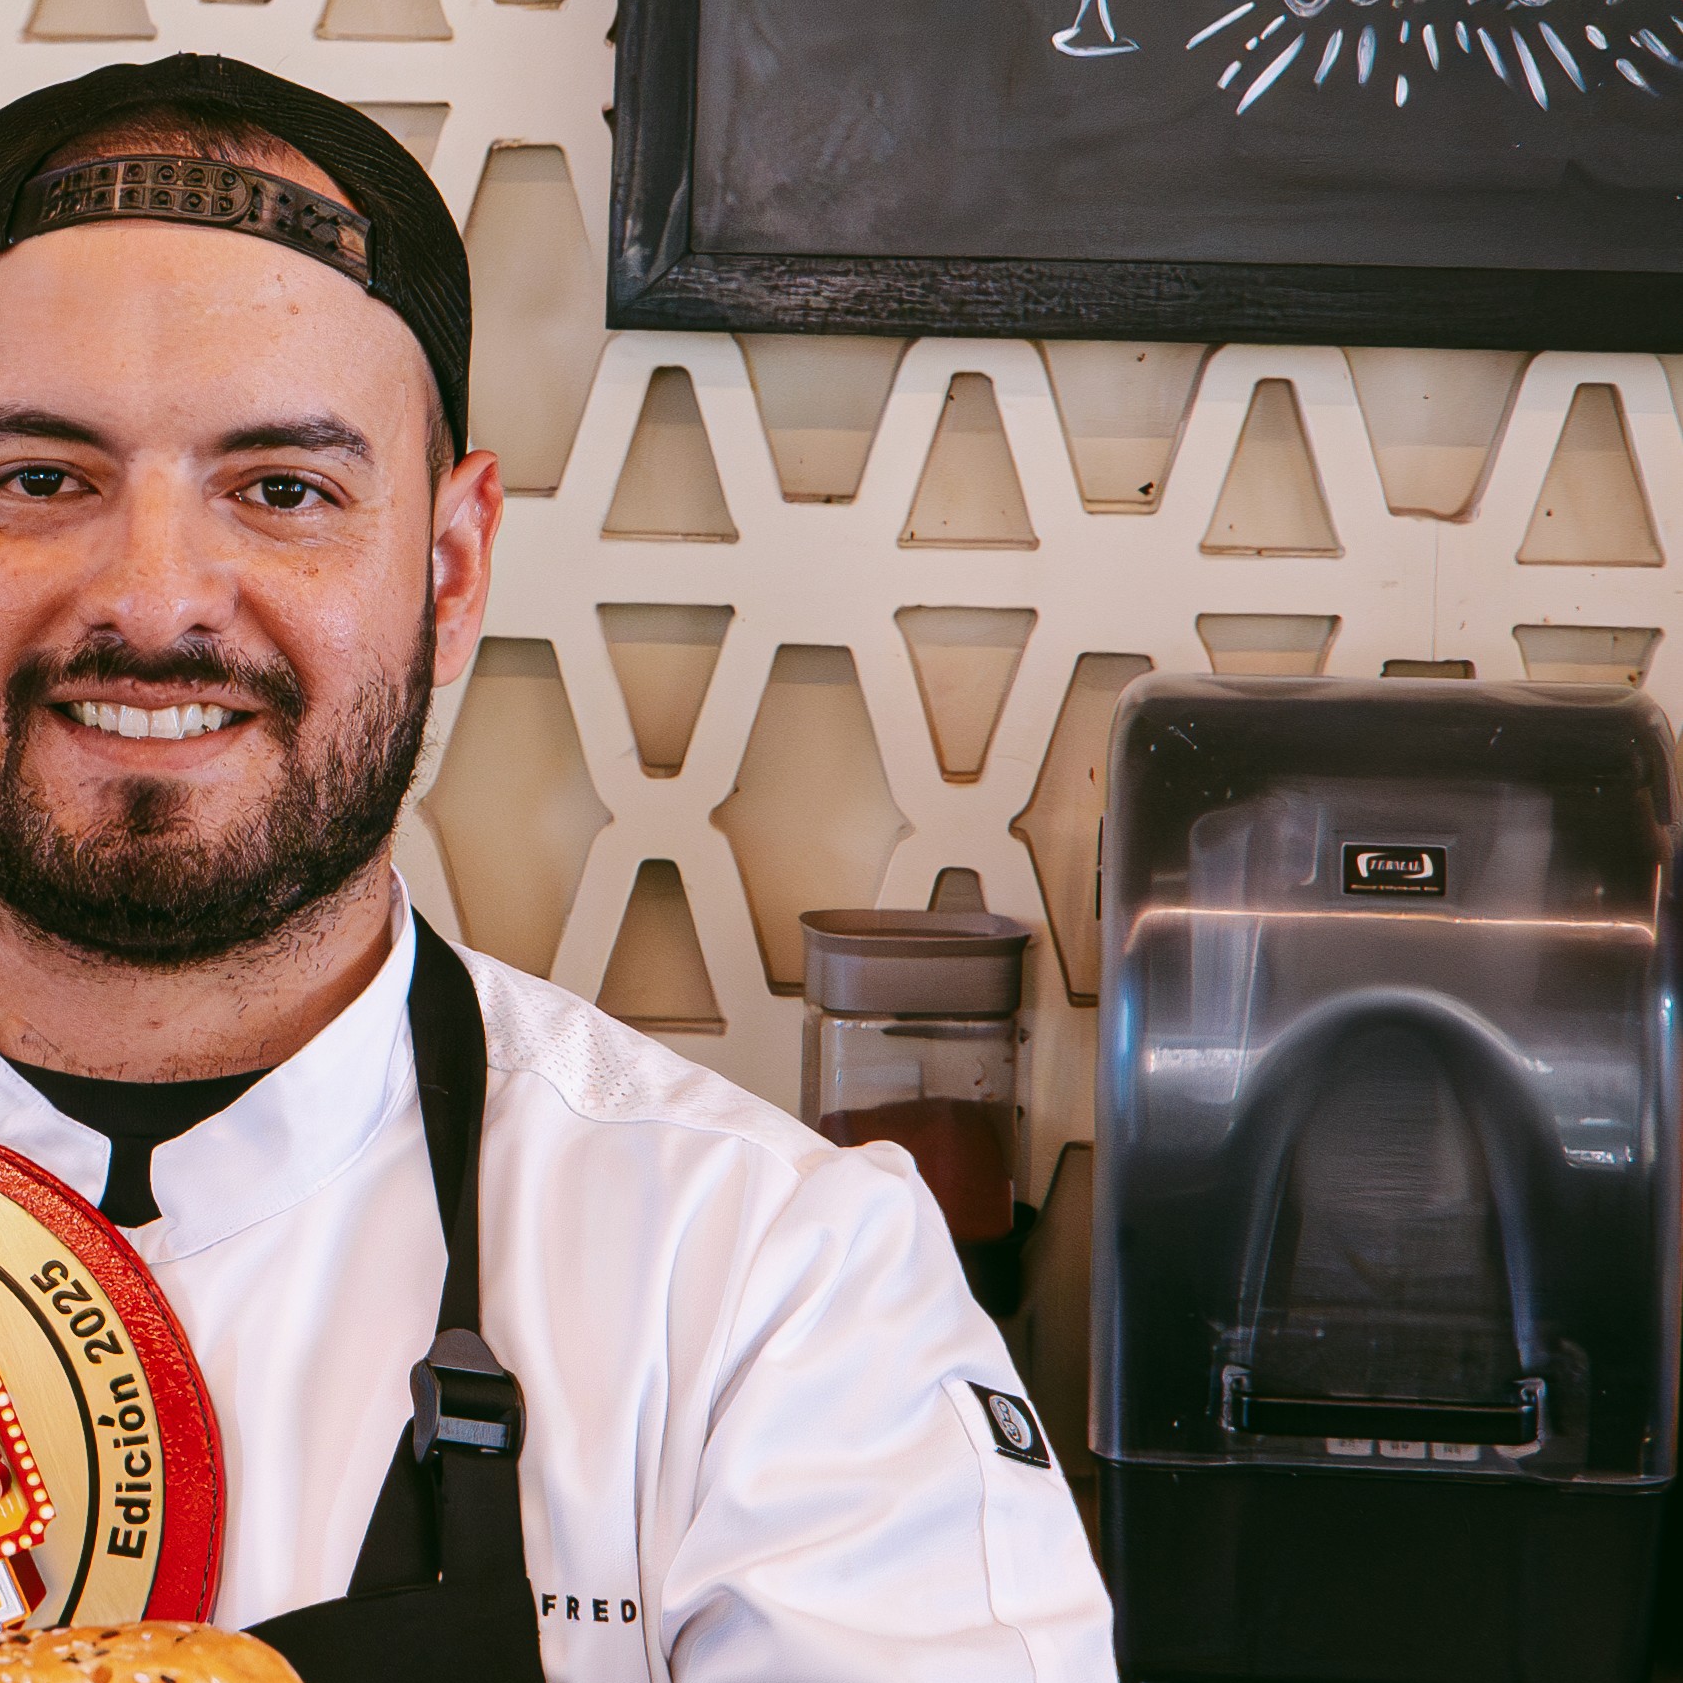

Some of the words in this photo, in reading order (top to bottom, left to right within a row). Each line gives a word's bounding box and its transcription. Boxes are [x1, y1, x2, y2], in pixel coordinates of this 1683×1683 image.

[29, 1259, 124, 1365] 2025
[98, 1373, 152, 1560] Edición
[541, 1592, 638, 1623] FRED
